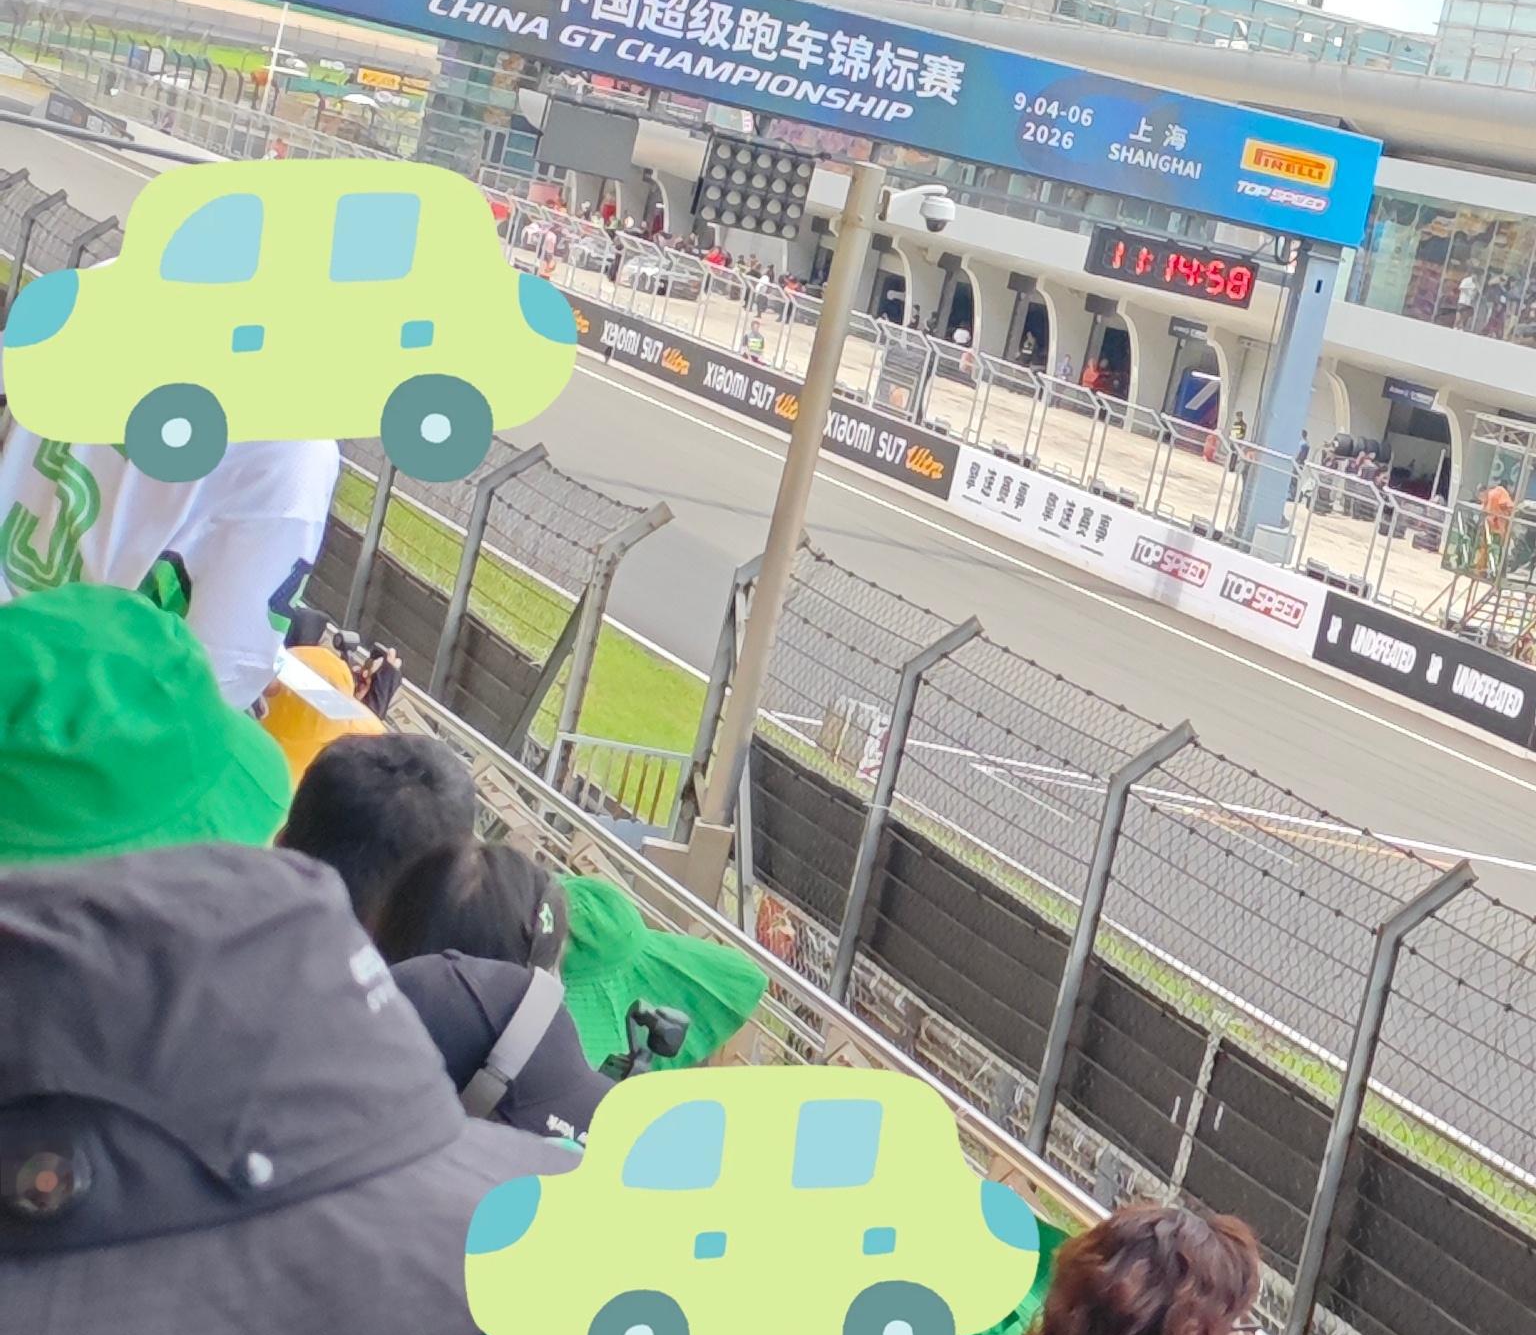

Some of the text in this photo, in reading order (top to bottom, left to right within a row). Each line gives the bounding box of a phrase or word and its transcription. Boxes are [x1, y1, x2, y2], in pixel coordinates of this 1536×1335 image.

[558, 24, 616, 53] GT
[616, 38, 914, 122] CHAMPIONSHIP
[1013, 92, 1094, 127] 9.04-06
[1022, 122, 1075, 150] 2026
[1128, 117, 1189, 152] 上海
[1108, 143, 1203, 180] SHANGHAI
[1252, 148, 1328, 183] PIRELLI
[1110, 240, 1252, 301] 11:14:58
[640, 339, 664, 365] SU7
[750, 380, 777, 412] SU7
[876, 431, 908, 465] SU7
[1350, 623, 1417, 674] UNDEFEATED
[1451, 663, 1525, 719] UNDEFEATED
